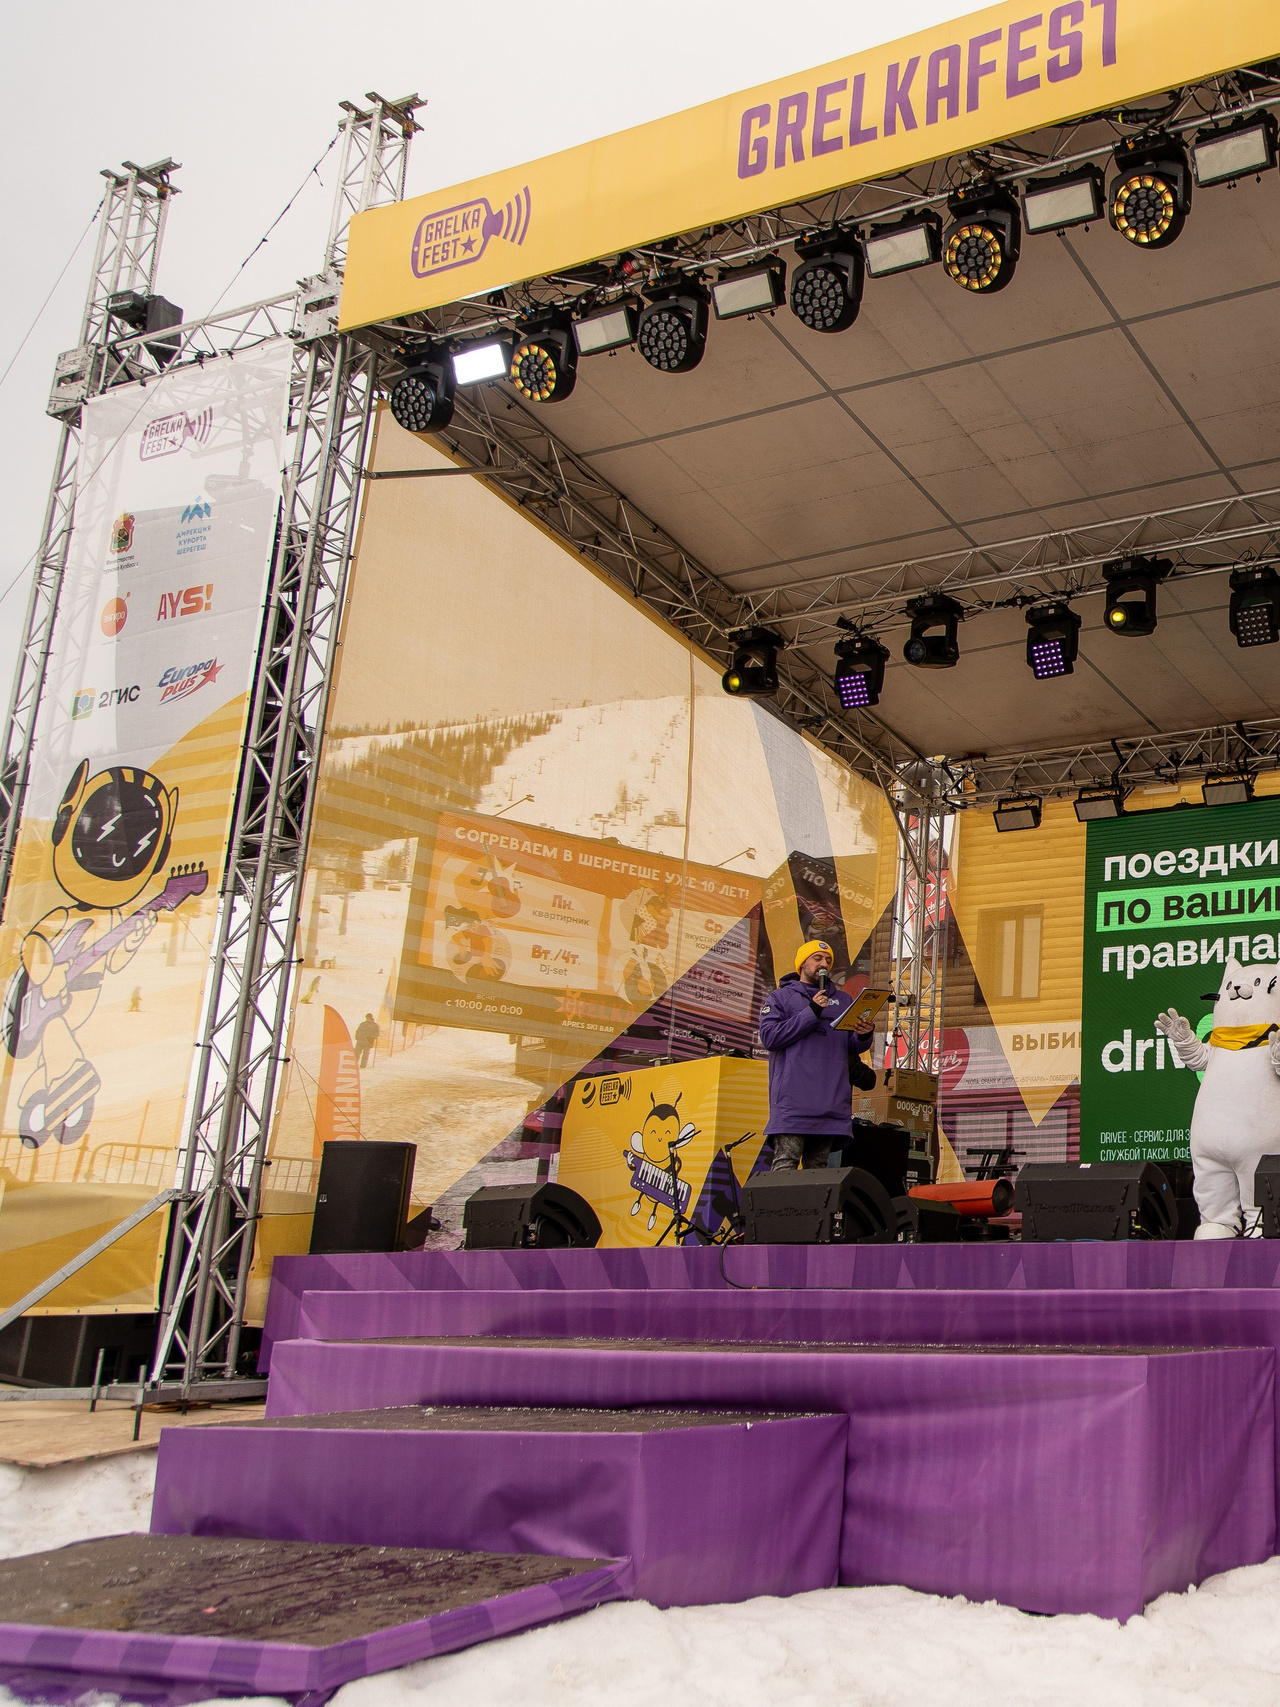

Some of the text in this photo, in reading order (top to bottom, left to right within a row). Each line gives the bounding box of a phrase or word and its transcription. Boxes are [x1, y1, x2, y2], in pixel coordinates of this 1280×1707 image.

[737, 0, 1118, 180] GRELKAFEST
[424, 207, 482, 244] GRELKA
[422, 238, 461, 268] FEST
[149, 418, 183, 440] GRELKA
[145, 437, 169, 455] FEST
[176, 525, 212, 539] ДИРЕКЦИЯ
[176, 543, 207, 556] ШЕРЕГЕШ
[178, 536, 207, 547] КУРОРТА
[157, 583, 214, 621] AYS!
[99, 685, 141, 708] 2ГИС
[454, 827, 750, 900] СОГРЕВАЕМ В ШЕРЕГЕШЕ УЖЕ 10 ЛЕТ!
[1104, 838, 1279, 882] поездки
[802, 867, 874, 910] ПО ЛЮБВ
[552, 894, 574, 910] Пн.
[532, 908, 590, 926] квартирник
[1103, 898, 1151, 927] по
[704, 919, 725, 935] Ср.
[684, 932, 742, 949] акустический
[695, 942, 730, 955] концерт
[531, 944, 581, 966] Вт./Чт.
[539, 963, 568, 977] Dj-set
[706, 986, 744, 999] вечером
[454, 999, 483, 1011] 10:00
[484, 1005, 498, 1014] до
[500, 1004, 523, 1016] 0:00
[586, 1023, 598, 1031] SKI
[599, 1025, 615, 1034] BAR
[1012, 1032, 1082, 1052] ВЫБИ
[1101, 1029, 1186, 1073] driv
[602, 1080, 619, 1092] GRELKA
[601, 1092, 613, 1102] FEST
[1100, 1131, 1127, 1144] DRIVEE
[1134, 1130, 1164, 1143] СЕРВИС
[1165, 1129, 1184, 1143] ДЛЯ
[1100, 1147, 1191, 1161] СЛУЖБОЙ ТАКСИ. ОФЕ
[1034, 1203, 1117, 1213] ProTone
